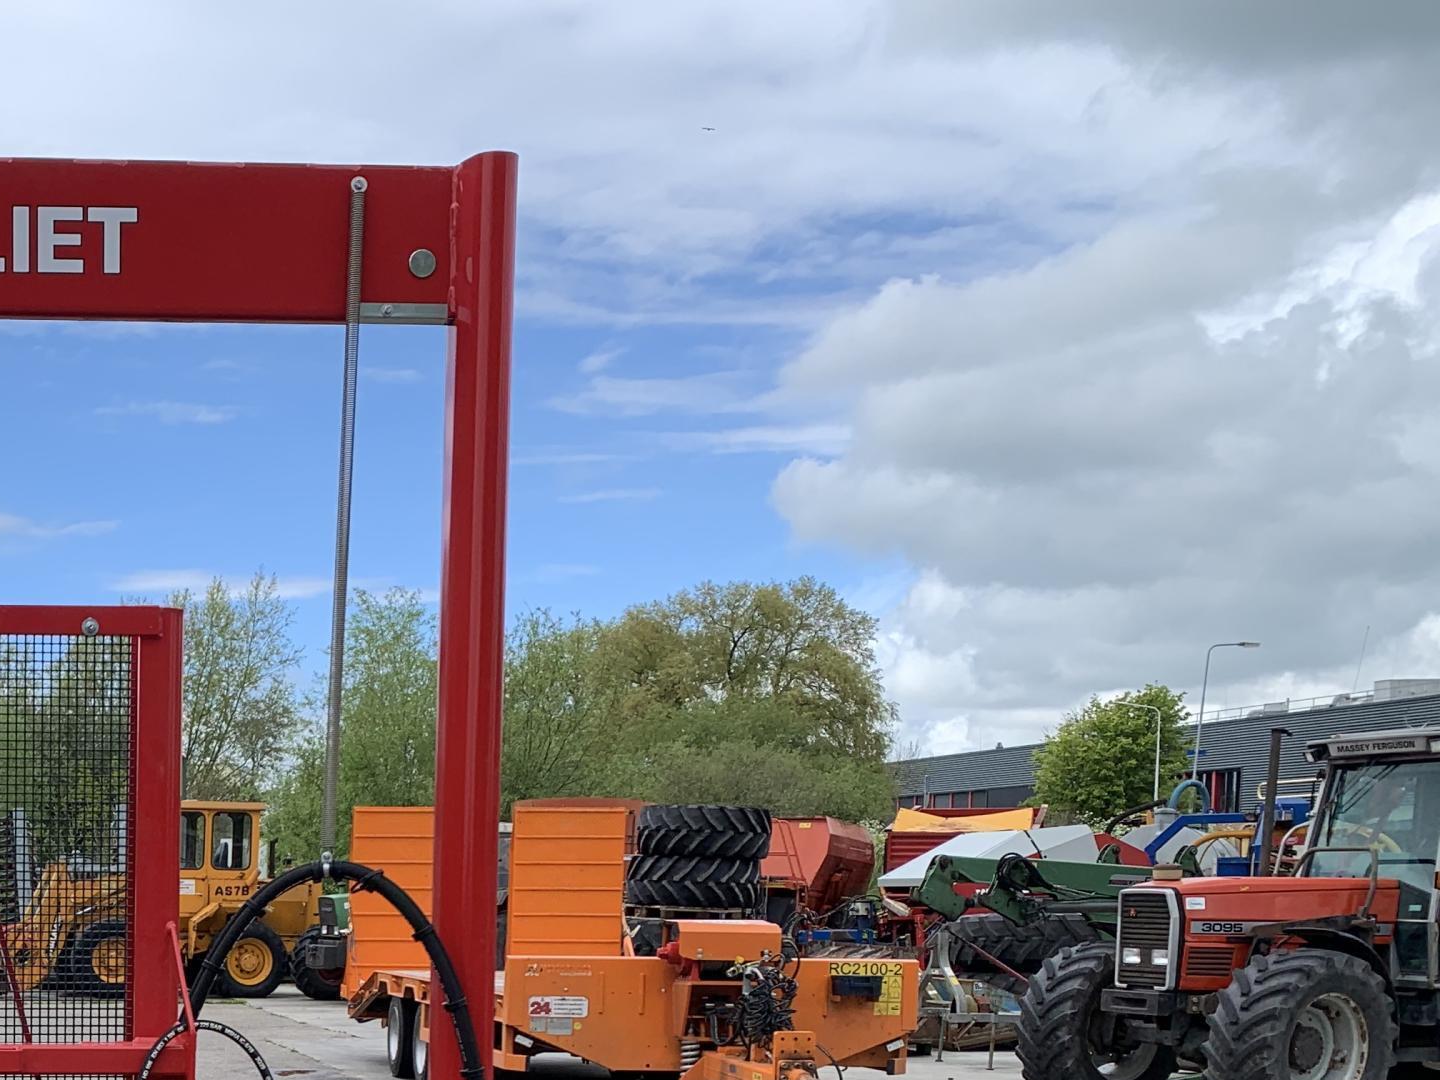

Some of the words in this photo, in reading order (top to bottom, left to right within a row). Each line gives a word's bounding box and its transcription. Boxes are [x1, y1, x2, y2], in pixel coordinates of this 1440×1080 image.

[1336, 743, 1371, 753] MASSEY
[1373, 740, 1416, 751] FERGUSON
[214, 885, 250, 896] AS7B
[1201, 922, 1244, 933] 3095
[829, 962, 903, 976] RC2100-2
[530, 1000, 552, 1015] 24
